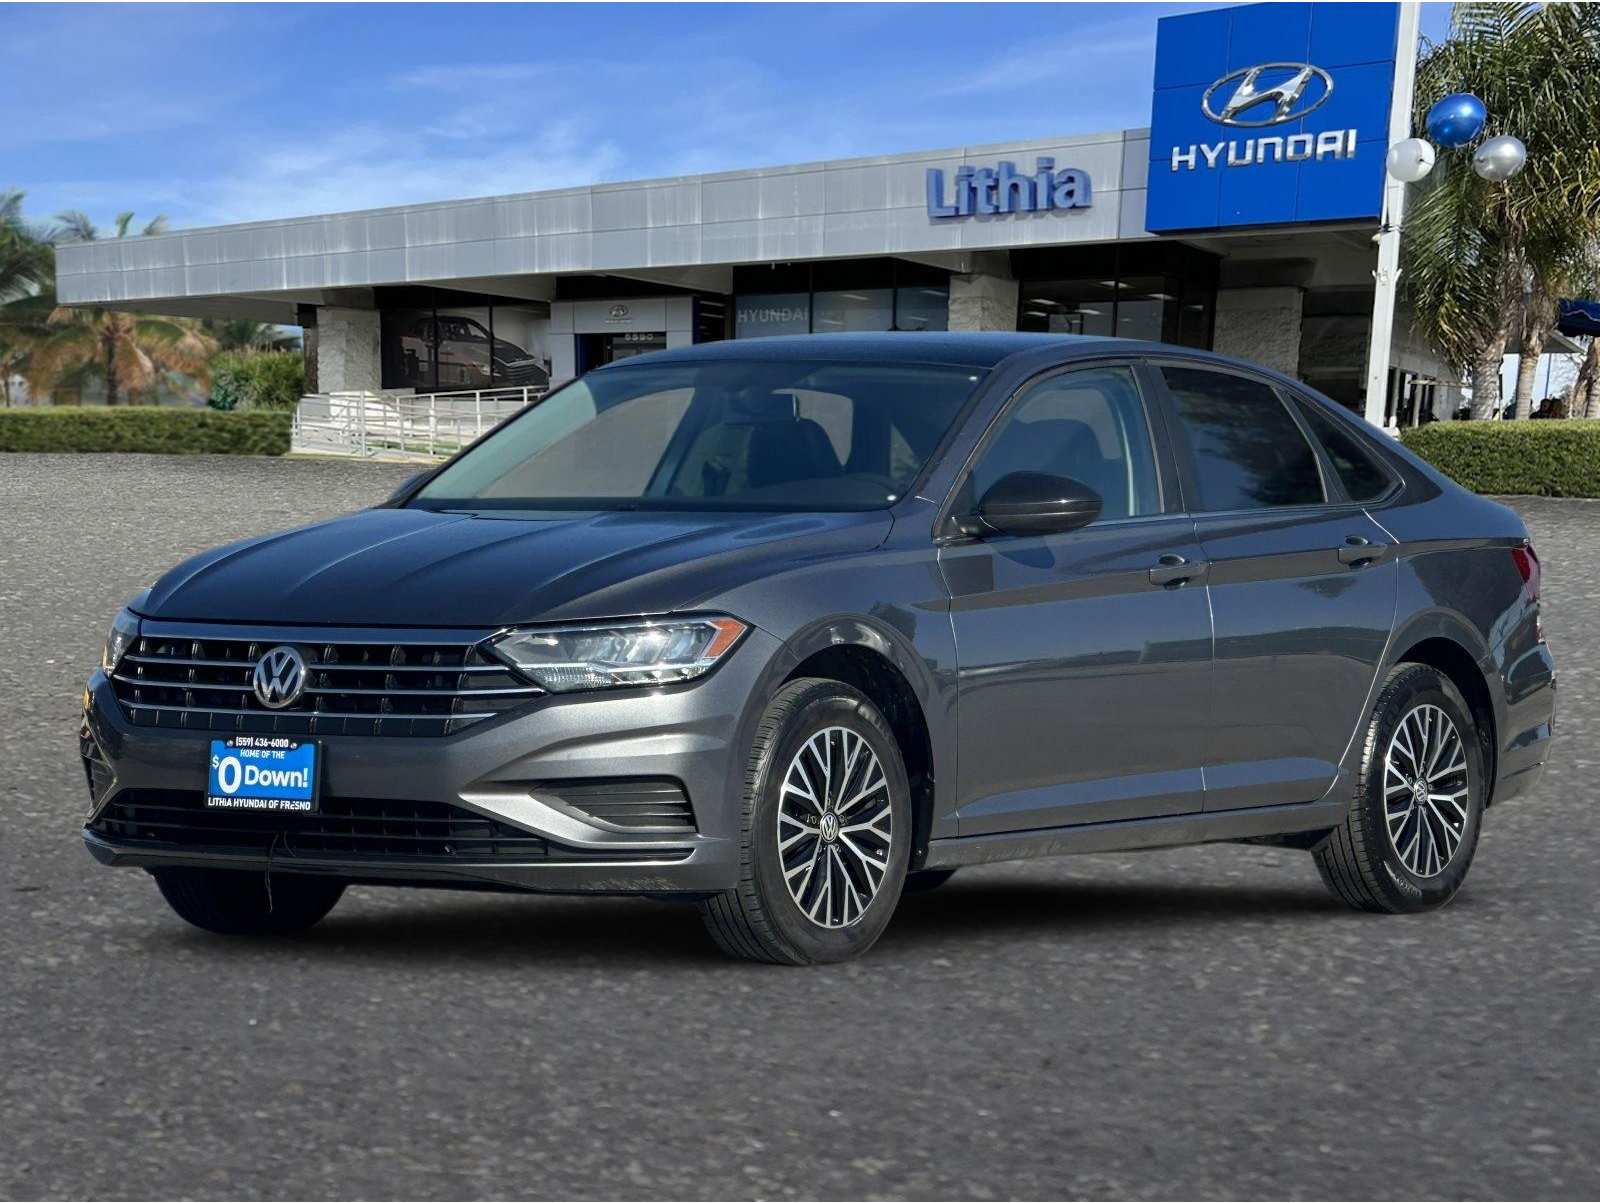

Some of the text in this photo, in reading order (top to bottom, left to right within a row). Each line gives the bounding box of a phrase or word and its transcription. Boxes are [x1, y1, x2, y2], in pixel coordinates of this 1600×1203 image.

[1171, 128, 1357, 171] HYUNDAI
[926, 157, 1092, 219] Lithia
[737, 307, 808, 322] HYUNDAI
[235, 736, 289, 748] (559) 436-6000
[240, 749, 285, 759] HOME OF THE
[244, 765, 308, 788] Down!
[208, 797, 311, 810] LITHIA HYUNDAI OF FRESNO
